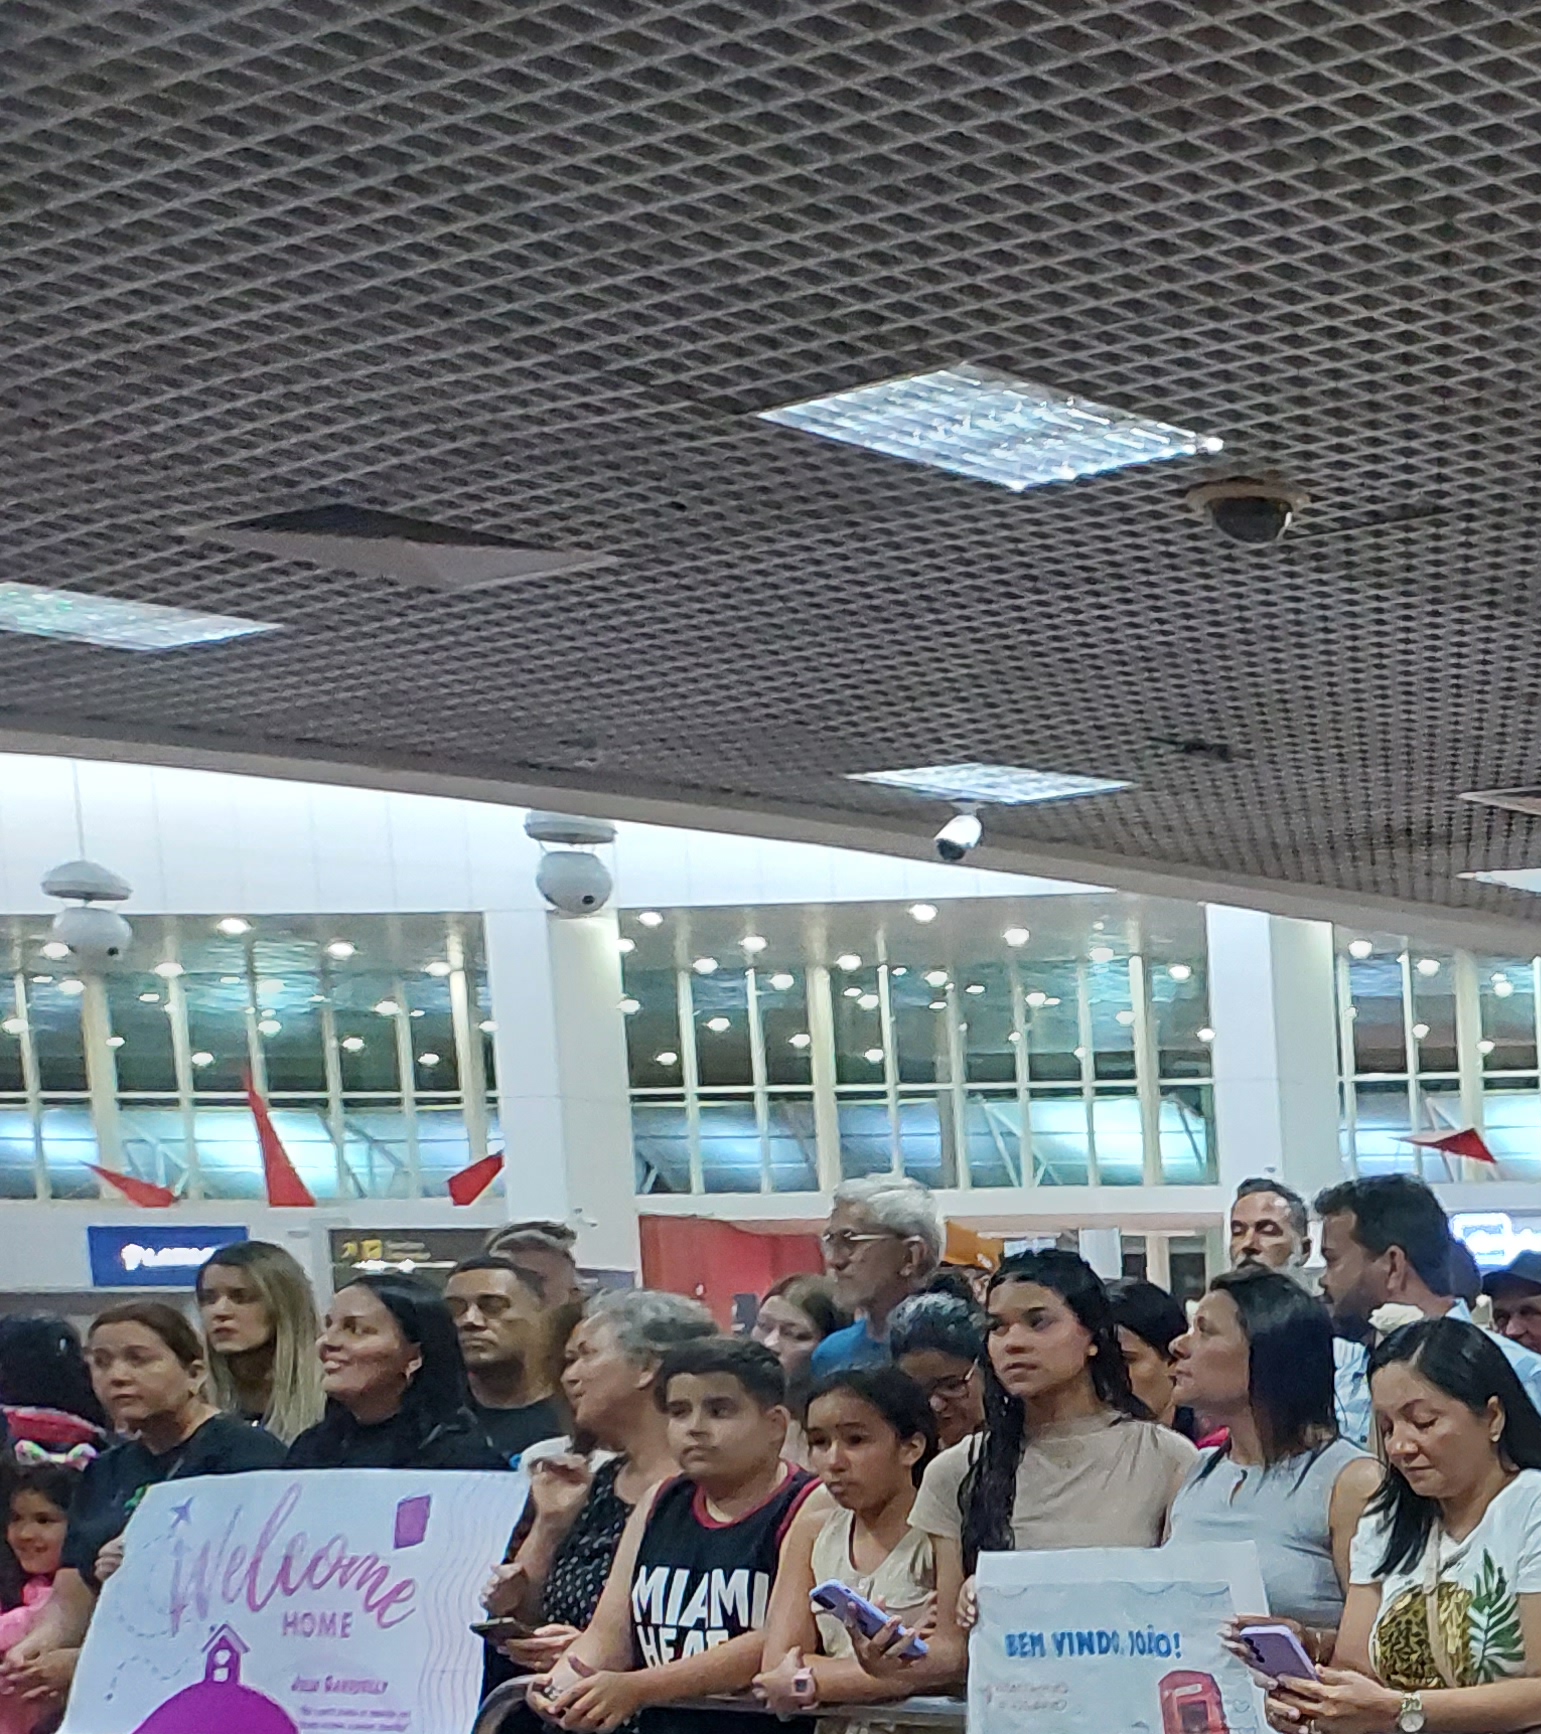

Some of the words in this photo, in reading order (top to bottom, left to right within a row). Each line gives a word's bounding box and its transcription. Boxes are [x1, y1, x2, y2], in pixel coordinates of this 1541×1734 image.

[169, 1482, 417, 1637] Welcome
[631, 1564, 770, 1629] MIAMI
[282, 1611, 353, 1639] HOME
[1005, 1632, 1046, 1658] BEM
